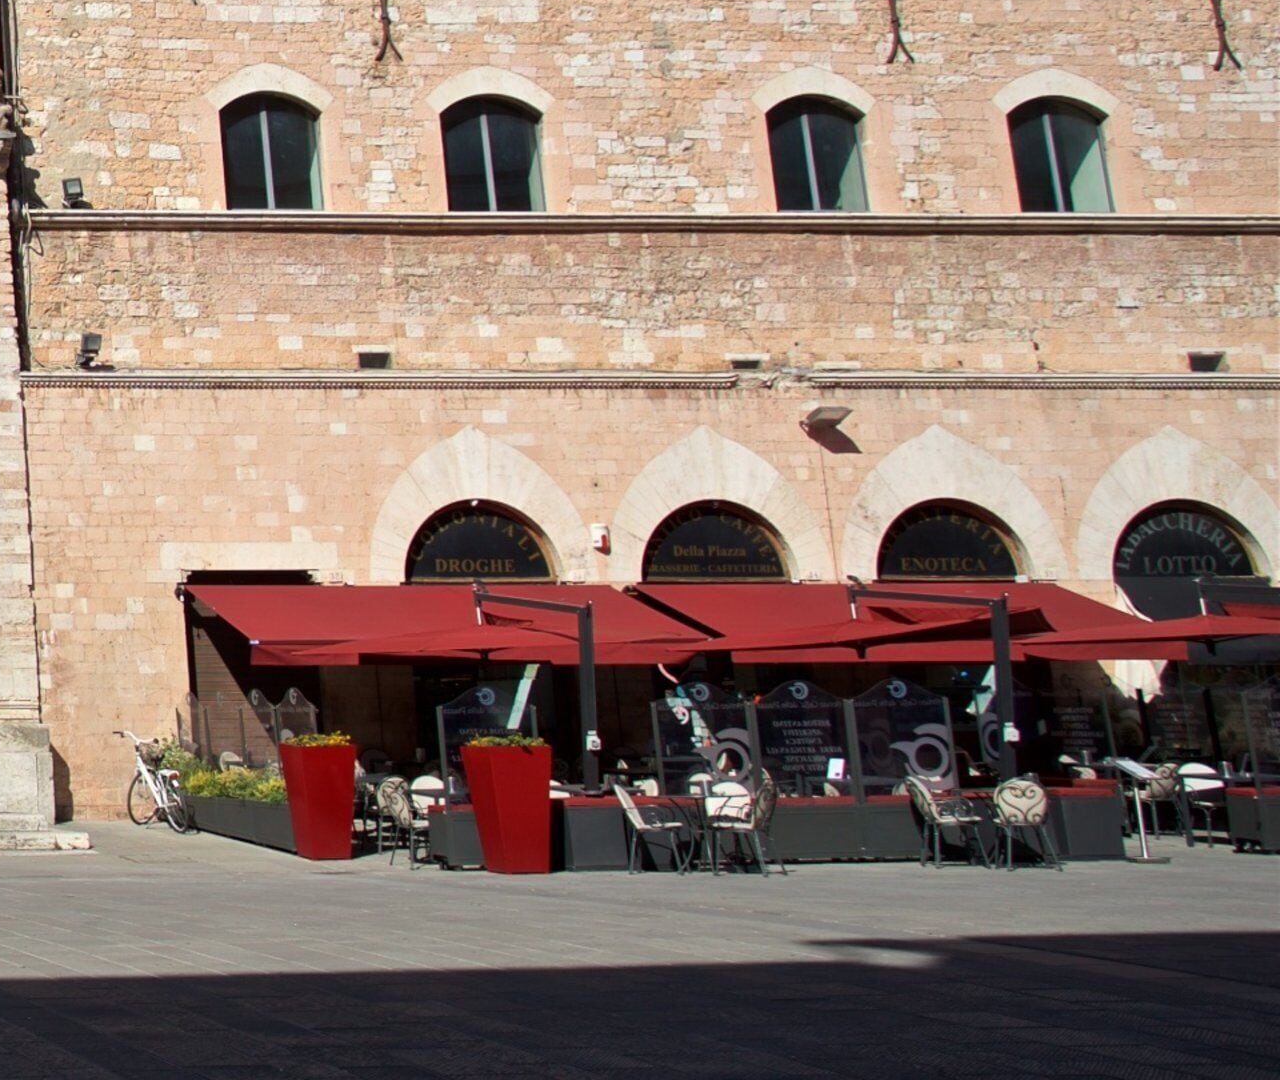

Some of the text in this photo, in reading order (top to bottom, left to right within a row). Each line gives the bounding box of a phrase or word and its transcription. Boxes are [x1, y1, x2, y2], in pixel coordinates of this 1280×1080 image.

[410, 510, 542, 563] COLONIALI
[673, 544, 747, 557] Della Piazza
[434, 557, 517, 573] DROGHE
[707, 564, 778, 573] CAFFETTERIA
[899, 556, 988, 572] ENOTECA
[1143, 555, 1218, 575] LOTTO
